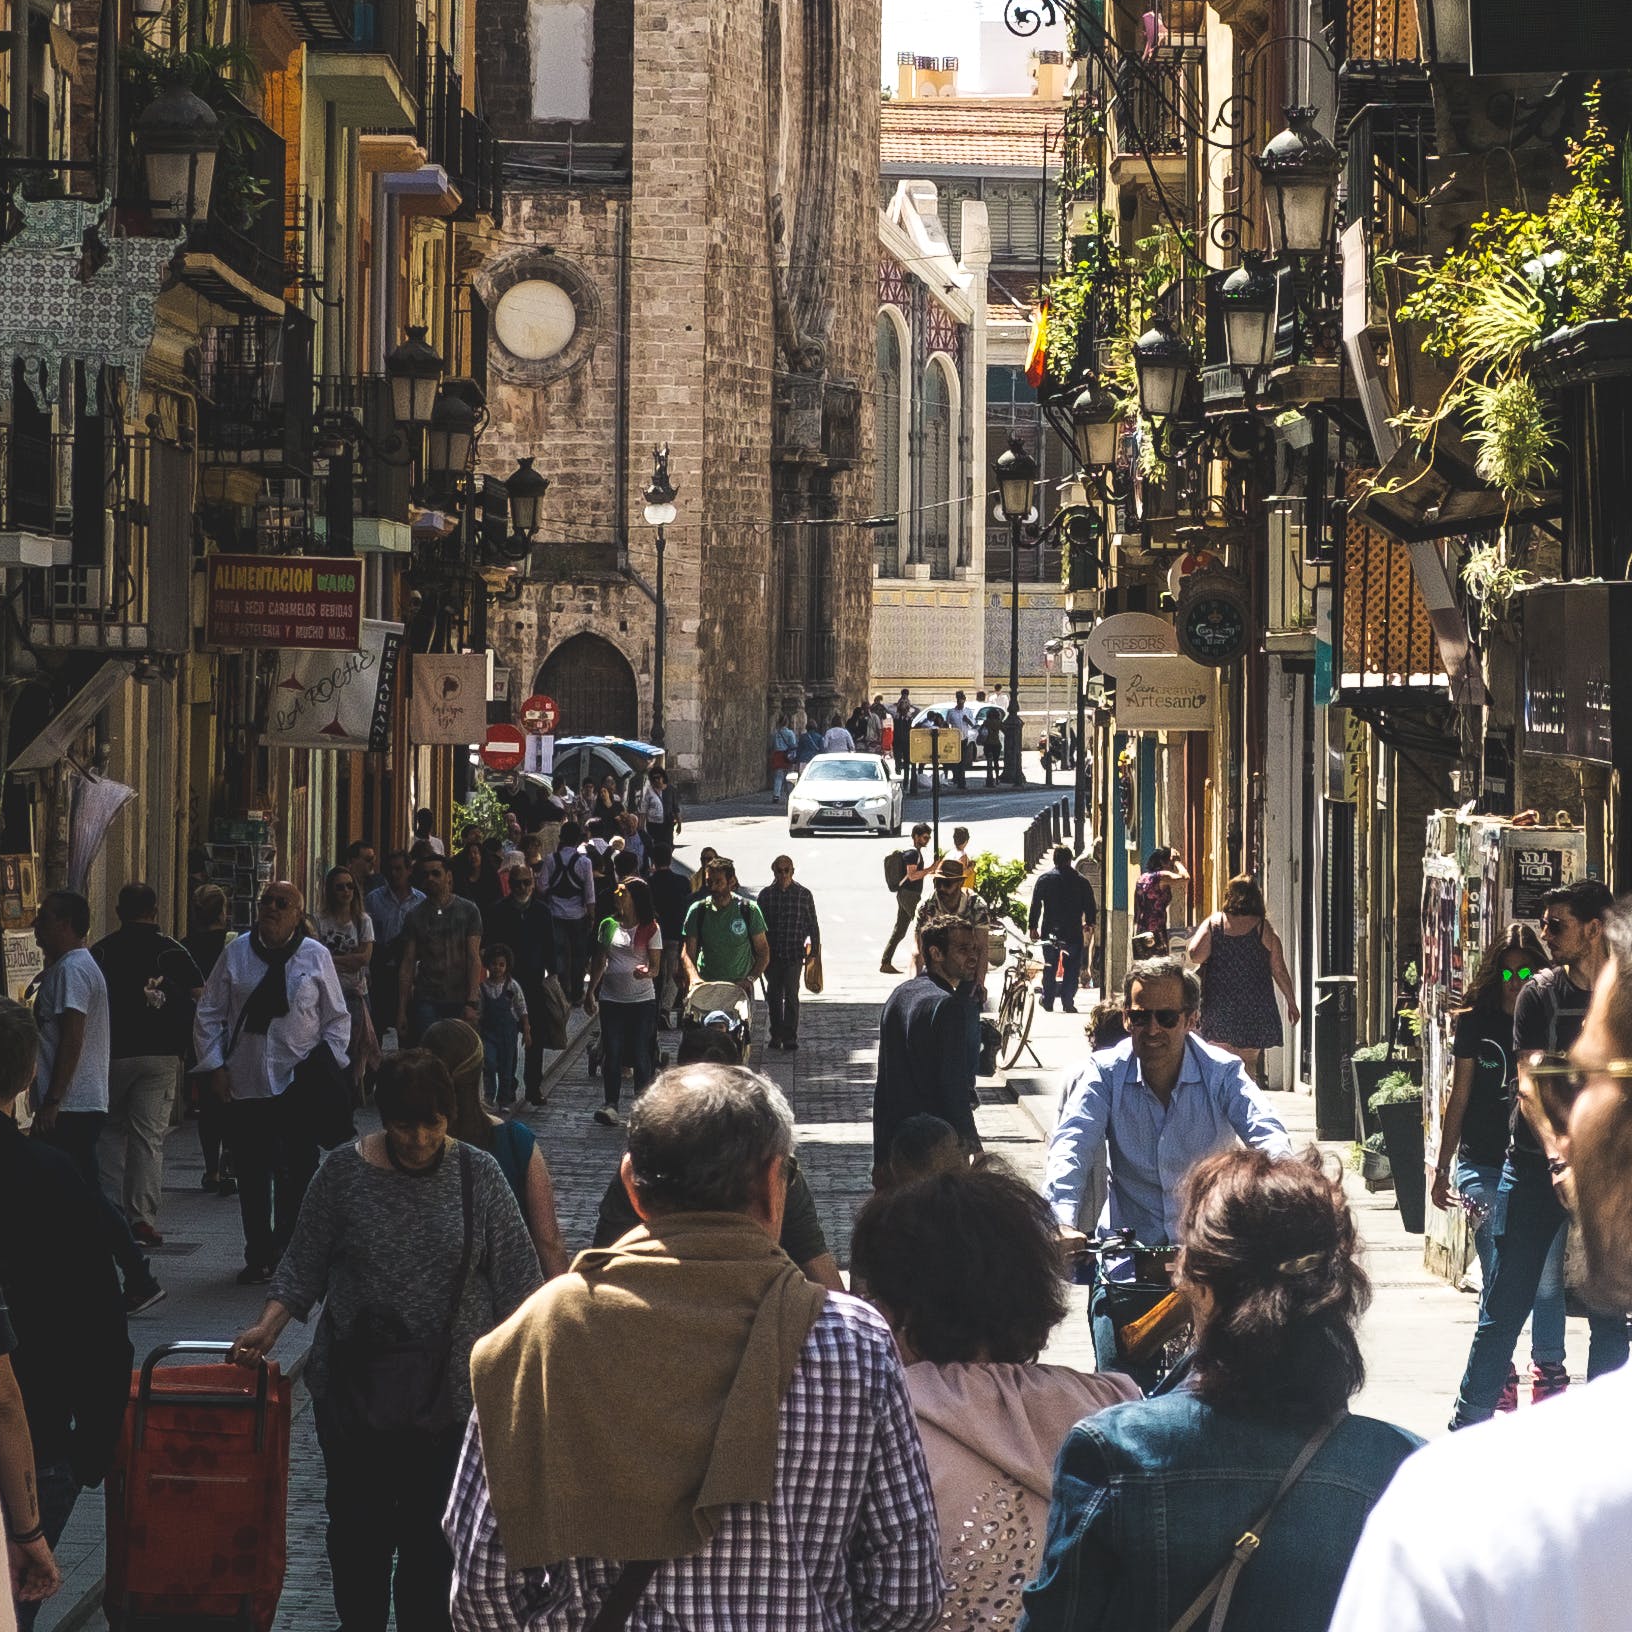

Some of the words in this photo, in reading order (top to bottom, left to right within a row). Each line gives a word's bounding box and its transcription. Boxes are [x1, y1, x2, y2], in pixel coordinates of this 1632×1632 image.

[214, 565, 313, 593] ALIMENTACION
[268, 601, 317, 617] CARAMELOS
[320, 603, 354, 619] BEBIDAS
[284, 624, 291, 638] Y
[295, 625, 324, 640] MUCHO
[1101, 637, 1168, 651] TRESORS
